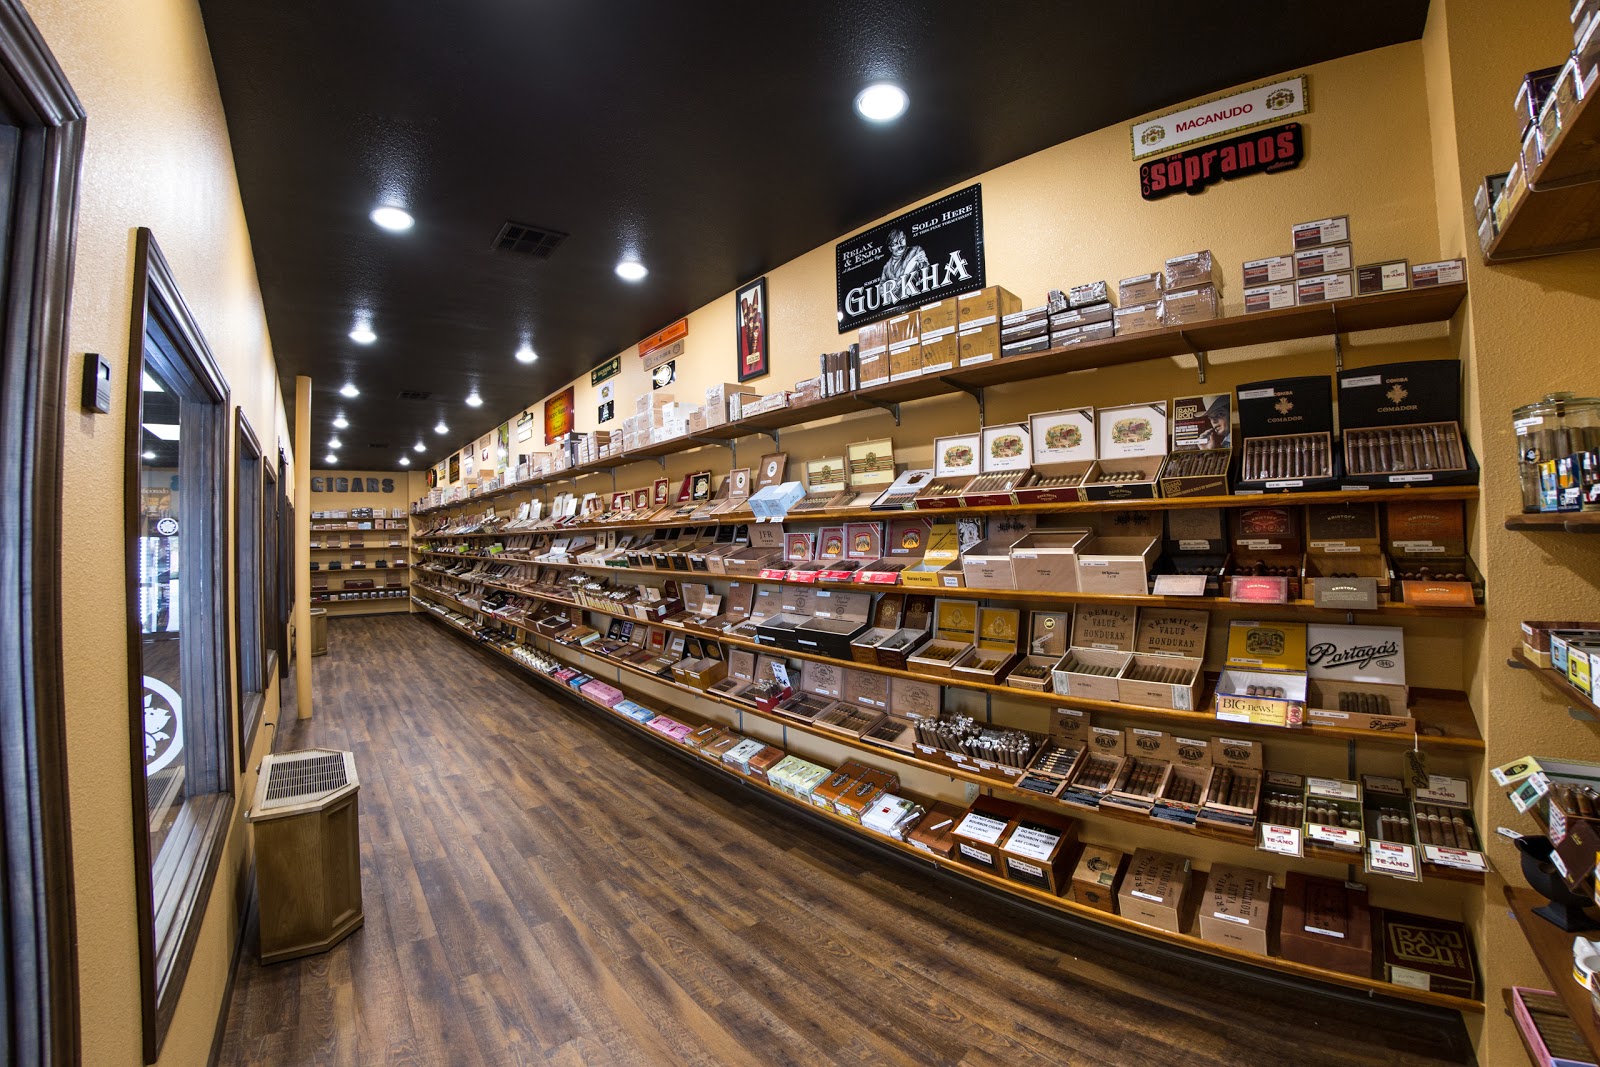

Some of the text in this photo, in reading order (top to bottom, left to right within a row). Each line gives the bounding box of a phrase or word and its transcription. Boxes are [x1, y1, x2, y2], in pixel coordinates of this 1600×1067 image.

[1175, 103, 1254, 134] MACANUDO
[1165, 153, 1183, 163] THE
[1141, 165, 1150, 196] CAO
[911, 204, 973, 233] SOLD HERE
[842, 241, 874, 261] RELAX
[843, 245, 884, 269] & ENJOY
[846, 250, 973, 317] GURKHA
[1385, 376, 1409, 384] COHIBA
[1377, 404, 1418, 413] COMADOR
[1267, 415, 1303, 423] COMADOR
[311, 477, 395, 493] CIGARS
[759, 530, 773, 539] JFR
[1082, 608, 1129, 623] PREMIUM
[1092, 617, 1117, 628] VALUE
[1148, 617, 1200, 632] PREMIUM
[1159, 626, 1186, 636] VALUE
[1083, 629, 1126, 641] HONDURAN
[1149, 636, 1196, 648] HONDURAN
[1222, 698, 1275, 713] BIG news!
[1017, 834, 1039, 843] BOURBON
[1266, 837, 1294, 846] TE-AMO
[1375, 857, 1409, 868] TE-AMO
[1144, 864, 1159, 886] VALUE
[1156, 861, 1174, 896] HONDURAN
[1216, 872, 1234, 913] PREMIUM
[1225, 882, 1240, 905] VALUE
[1240, 878, 1256, 916] HONDURAN
[1396, 927, 1463, 949] RAM
[1400, 942, 1455, 965] ROD
